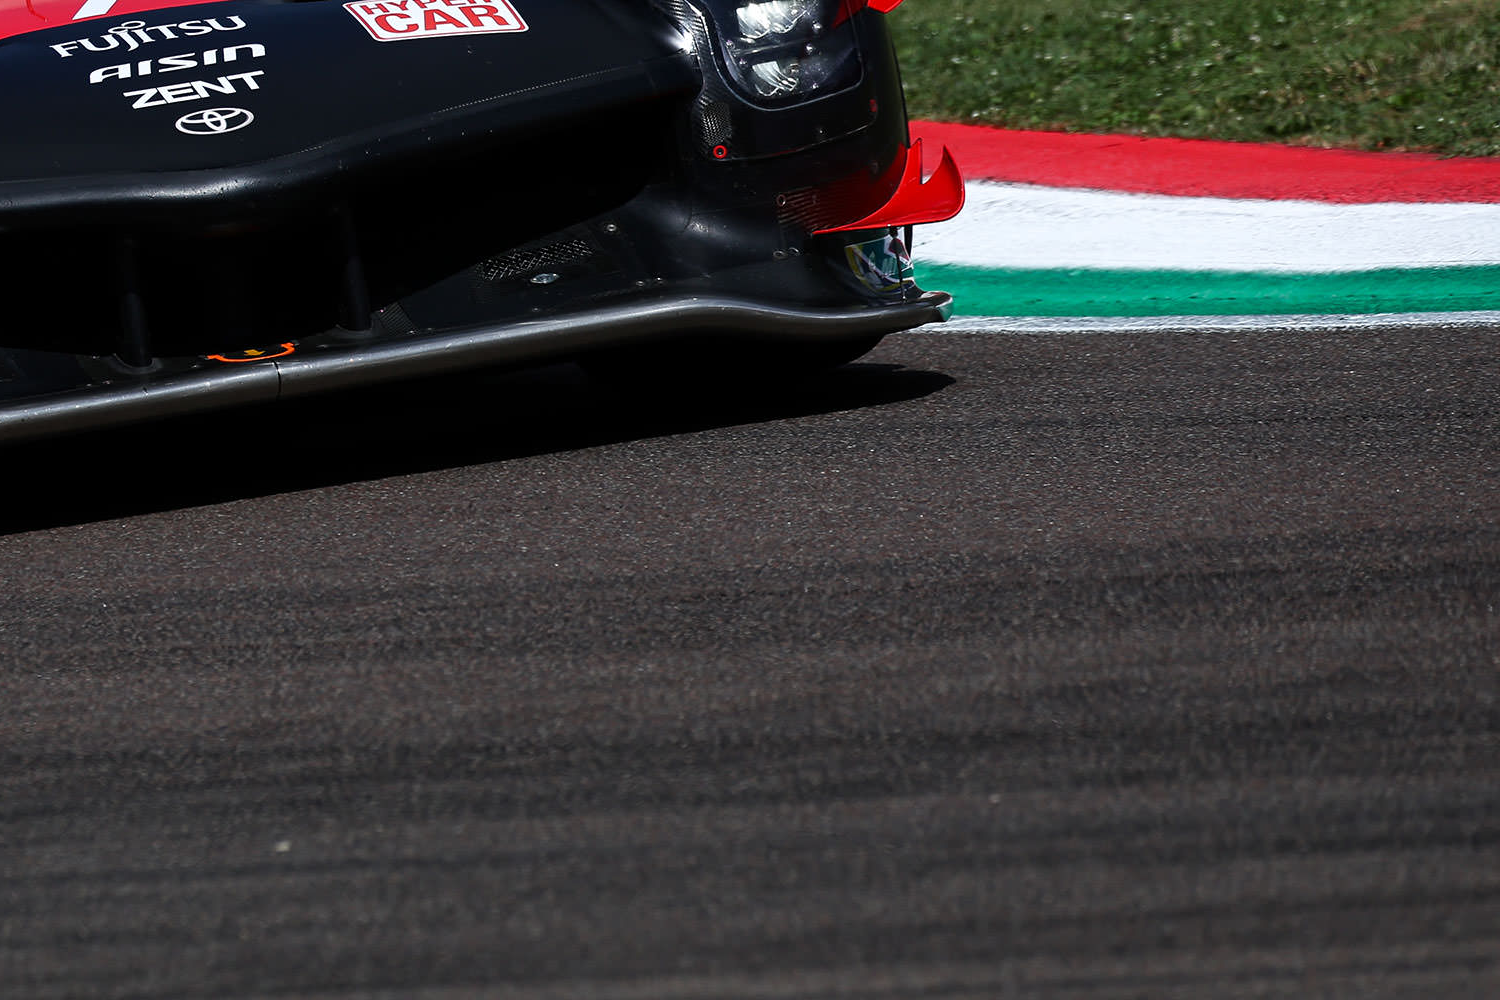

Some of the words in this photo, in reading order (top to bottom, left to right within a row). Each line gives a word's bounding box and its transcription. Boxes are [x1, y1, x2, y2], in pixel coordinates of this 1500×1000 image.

[50, 15, 247, 58] FUJITSU
[374, 4, 510, 34] CAR
[89, 43, 266, 84] AISIN
[123, 70, 266, 110] ZENT
